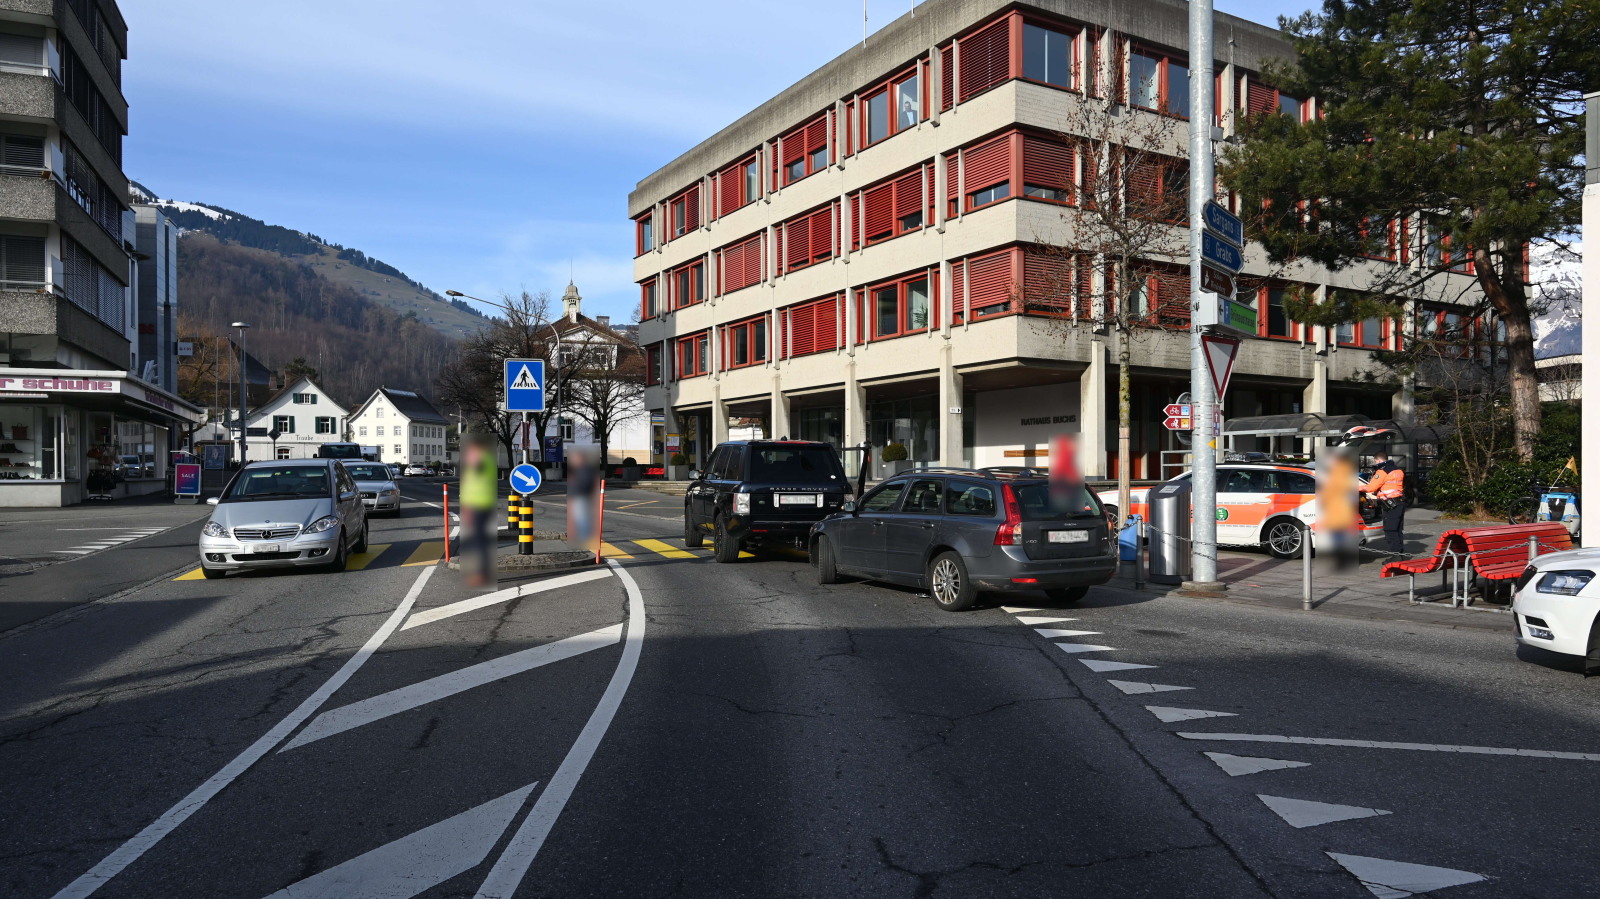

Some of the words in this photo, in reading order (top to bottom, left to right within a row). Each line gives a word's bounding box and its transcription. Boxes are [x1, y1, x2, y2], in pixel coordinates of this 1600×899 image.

[1212, 206, 1234, 234] Sargans
[1216, 241, 1233, 264] Grabs
[1225, 305, 1229, 319] P
[1230, 307, 1255, 328] Grünaustrasse
[22, 376, 113, 391] schuhe
[1021, 416, 1051, 426] RATHAUS
[1053, 415, 1076, 424] BUCHS
